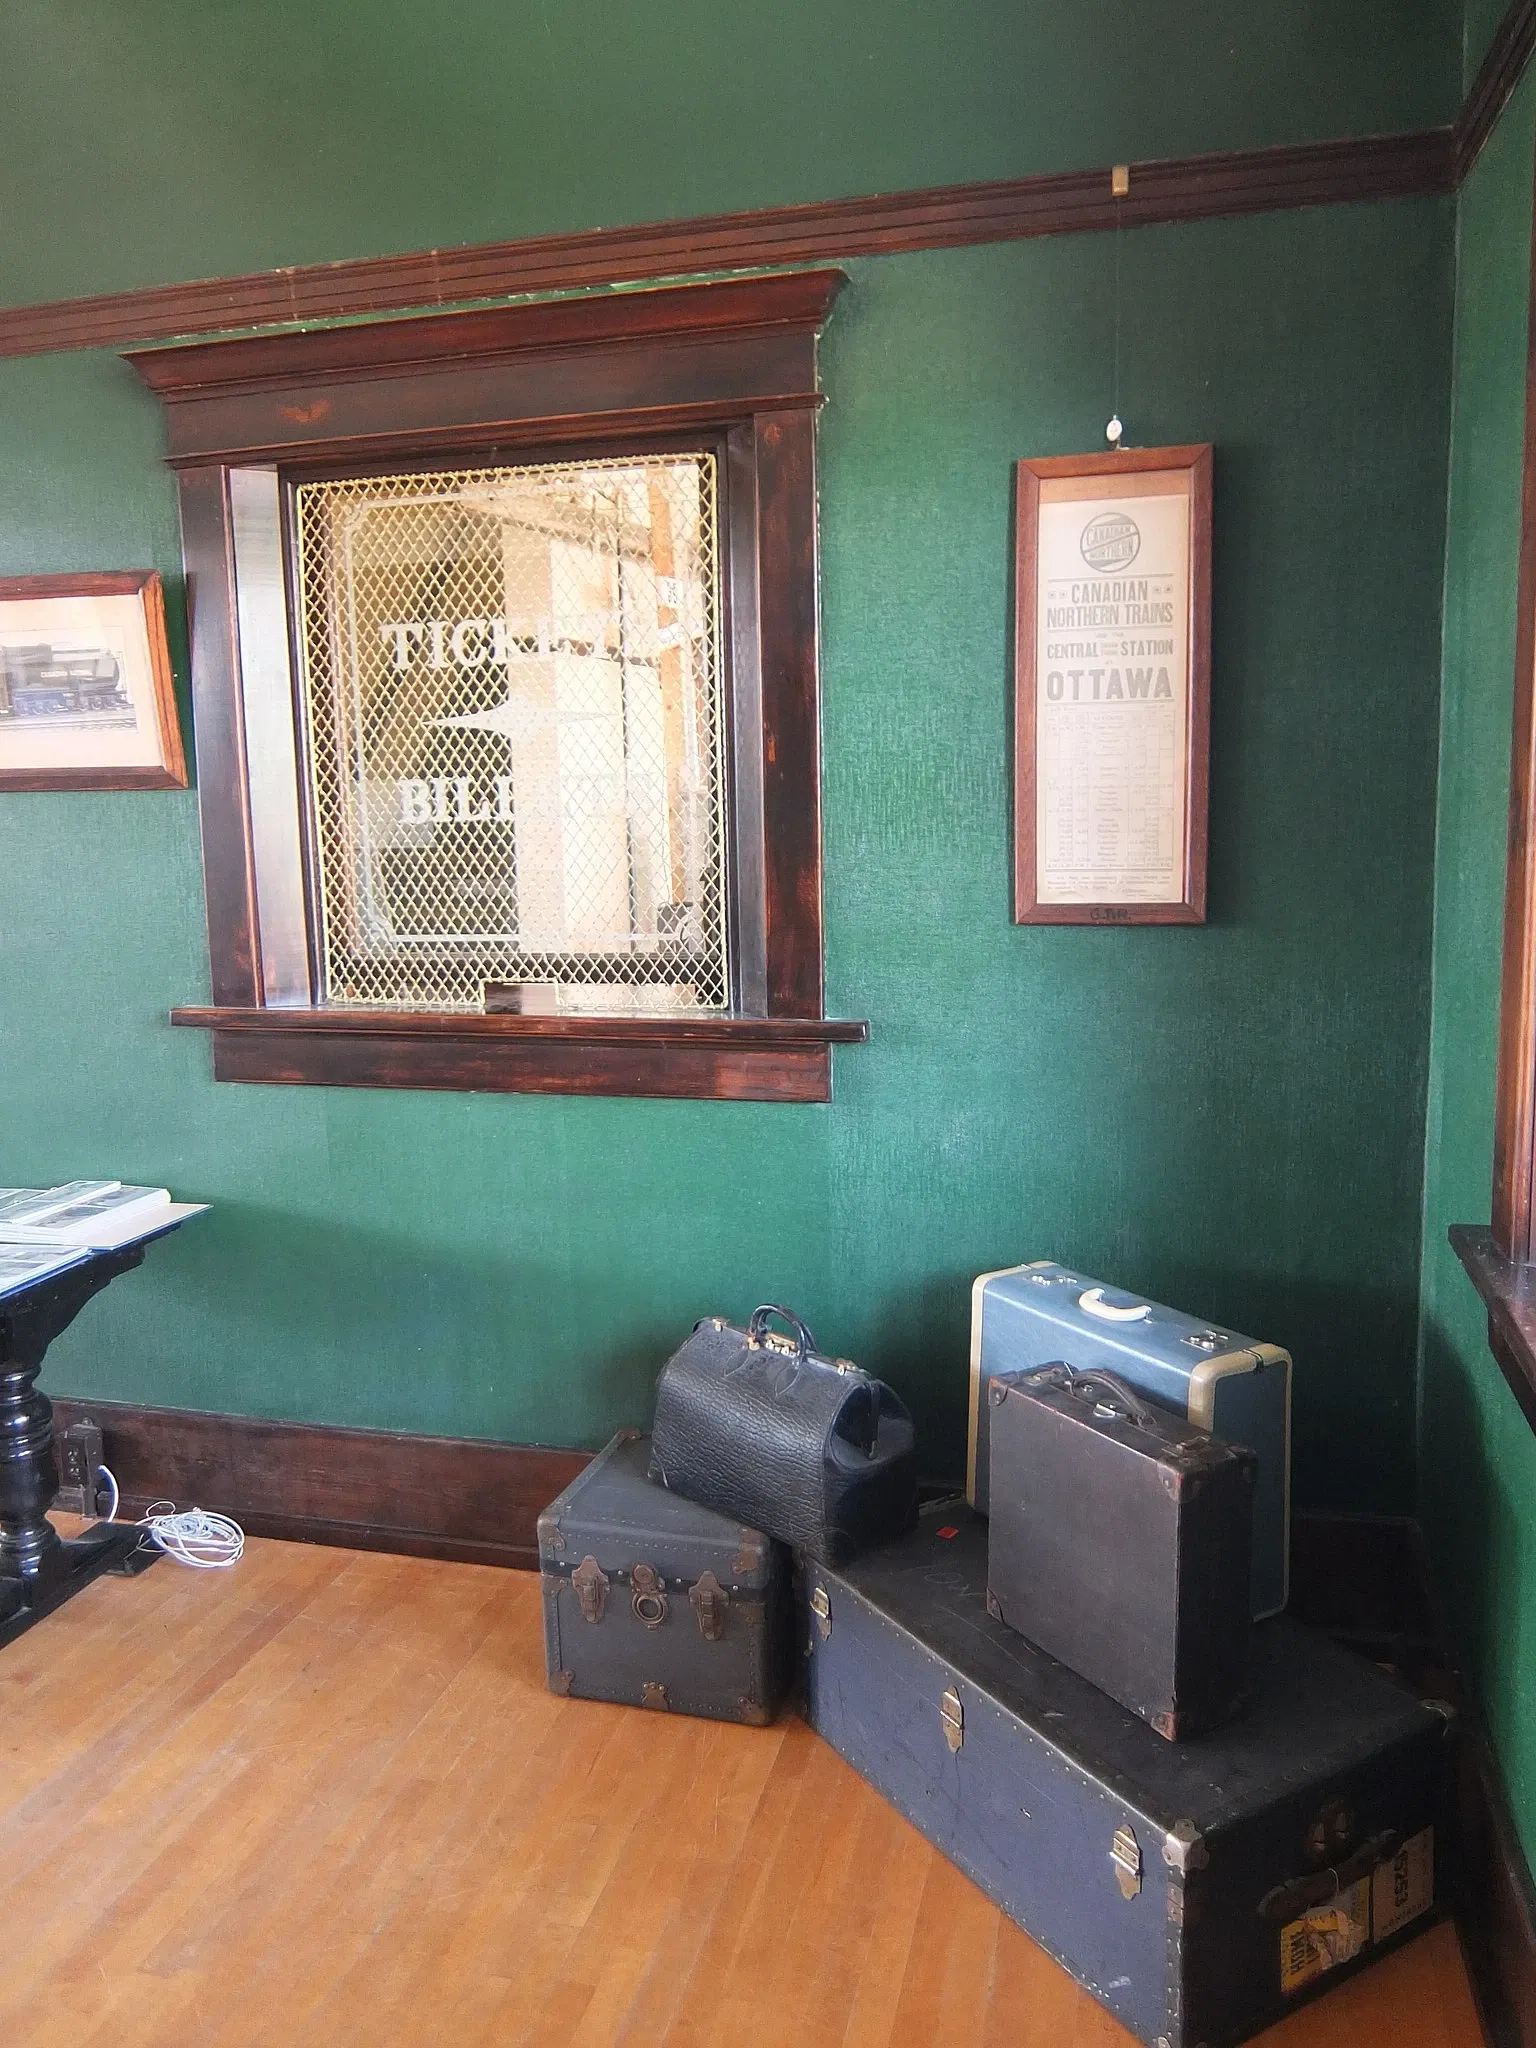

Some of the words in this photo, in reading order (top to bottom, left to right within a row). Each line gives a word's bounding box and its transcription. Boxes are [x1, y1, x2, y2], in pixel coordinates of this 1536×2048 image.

[1071, 579, 1148, 604] CANADIAN
[1047, 604, 1119, 628] NORTHERN
[1124, 602, 1173, 625] TRAINS
[1047, 642, 1099, 659] CENTRAL
[1120, 639, 1174, 657] STATION
[1046, 667, 1172, 700] OTTAWA
